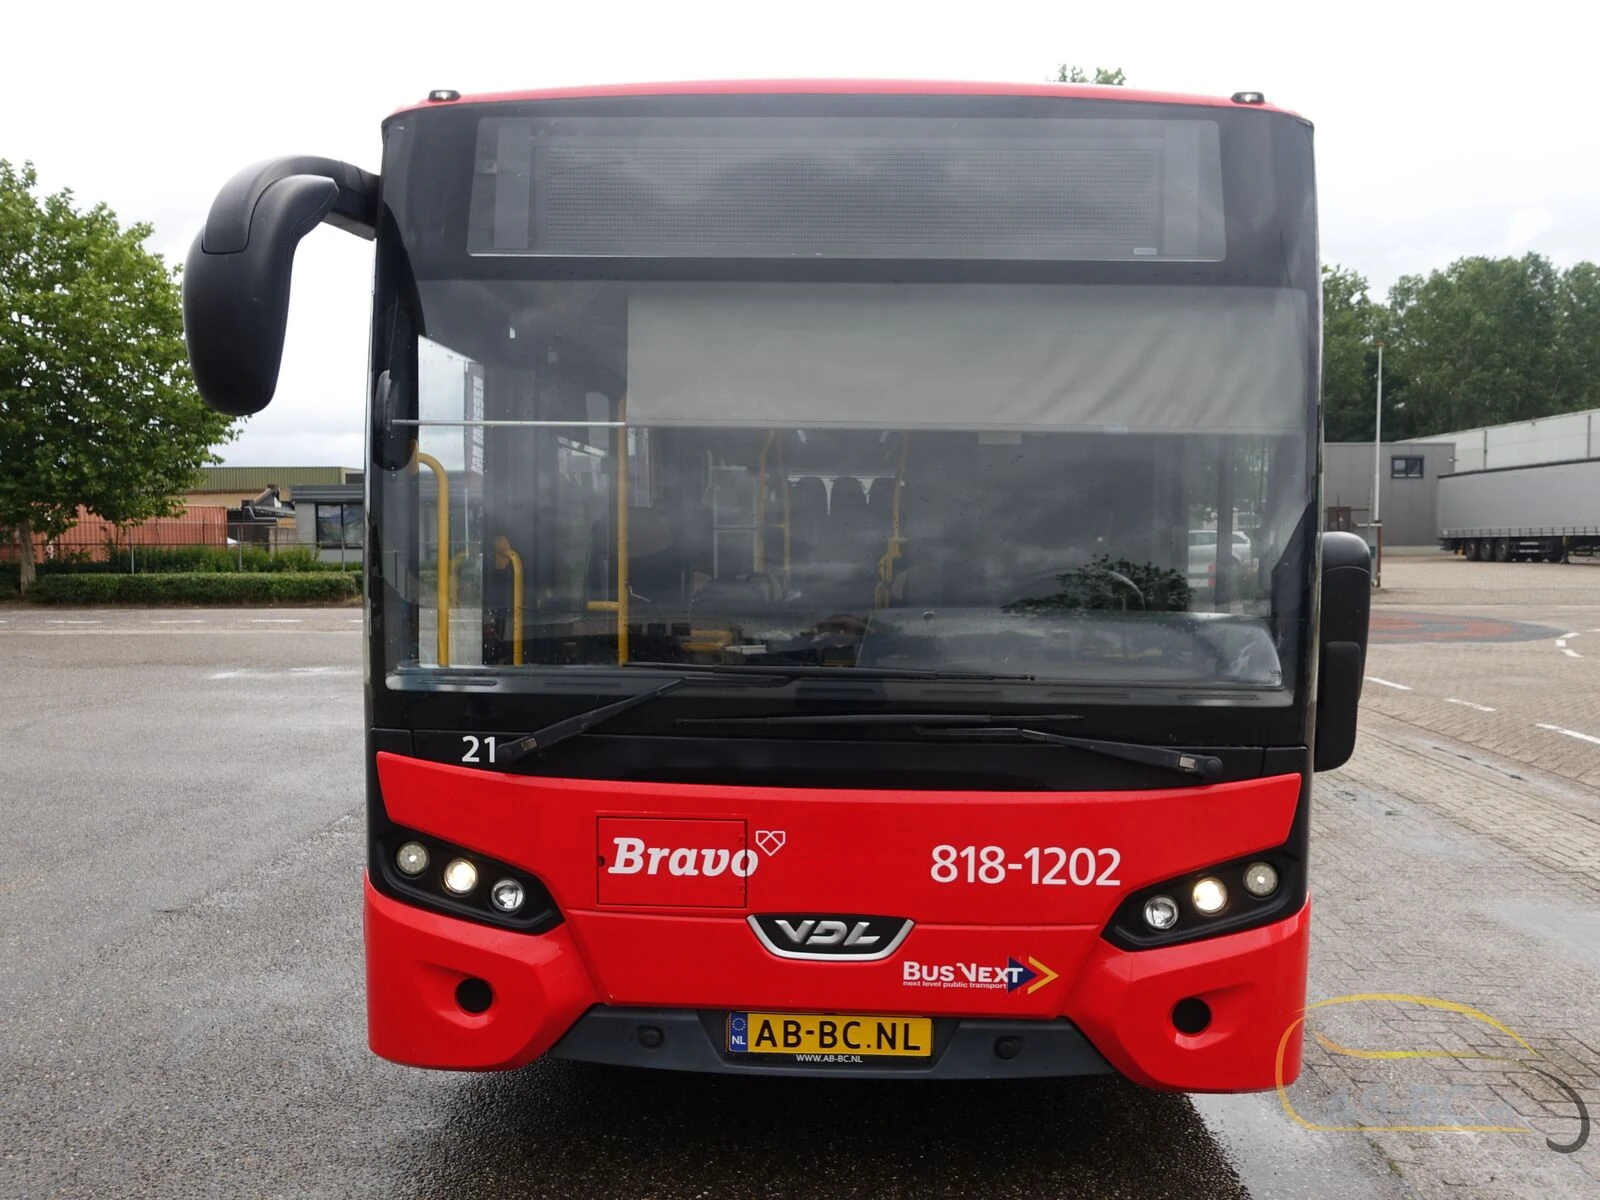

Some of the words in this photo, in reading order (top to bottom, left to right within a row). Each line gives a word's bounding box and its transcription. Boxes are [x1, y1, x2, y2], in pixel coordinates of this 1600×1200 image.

[462, 735, 495, 763] 21
[607, 837, 759, 878] Bravo
[930, 844, 1121, 886] 818-1202
[774, 919, 881, 946] VDL
[732, 1035, 746, 1045] NL
[755, 1019, 921, 1051] AB-BC.NL
[796, 1054, 863, 1063] WWW.AB-BC.NL
